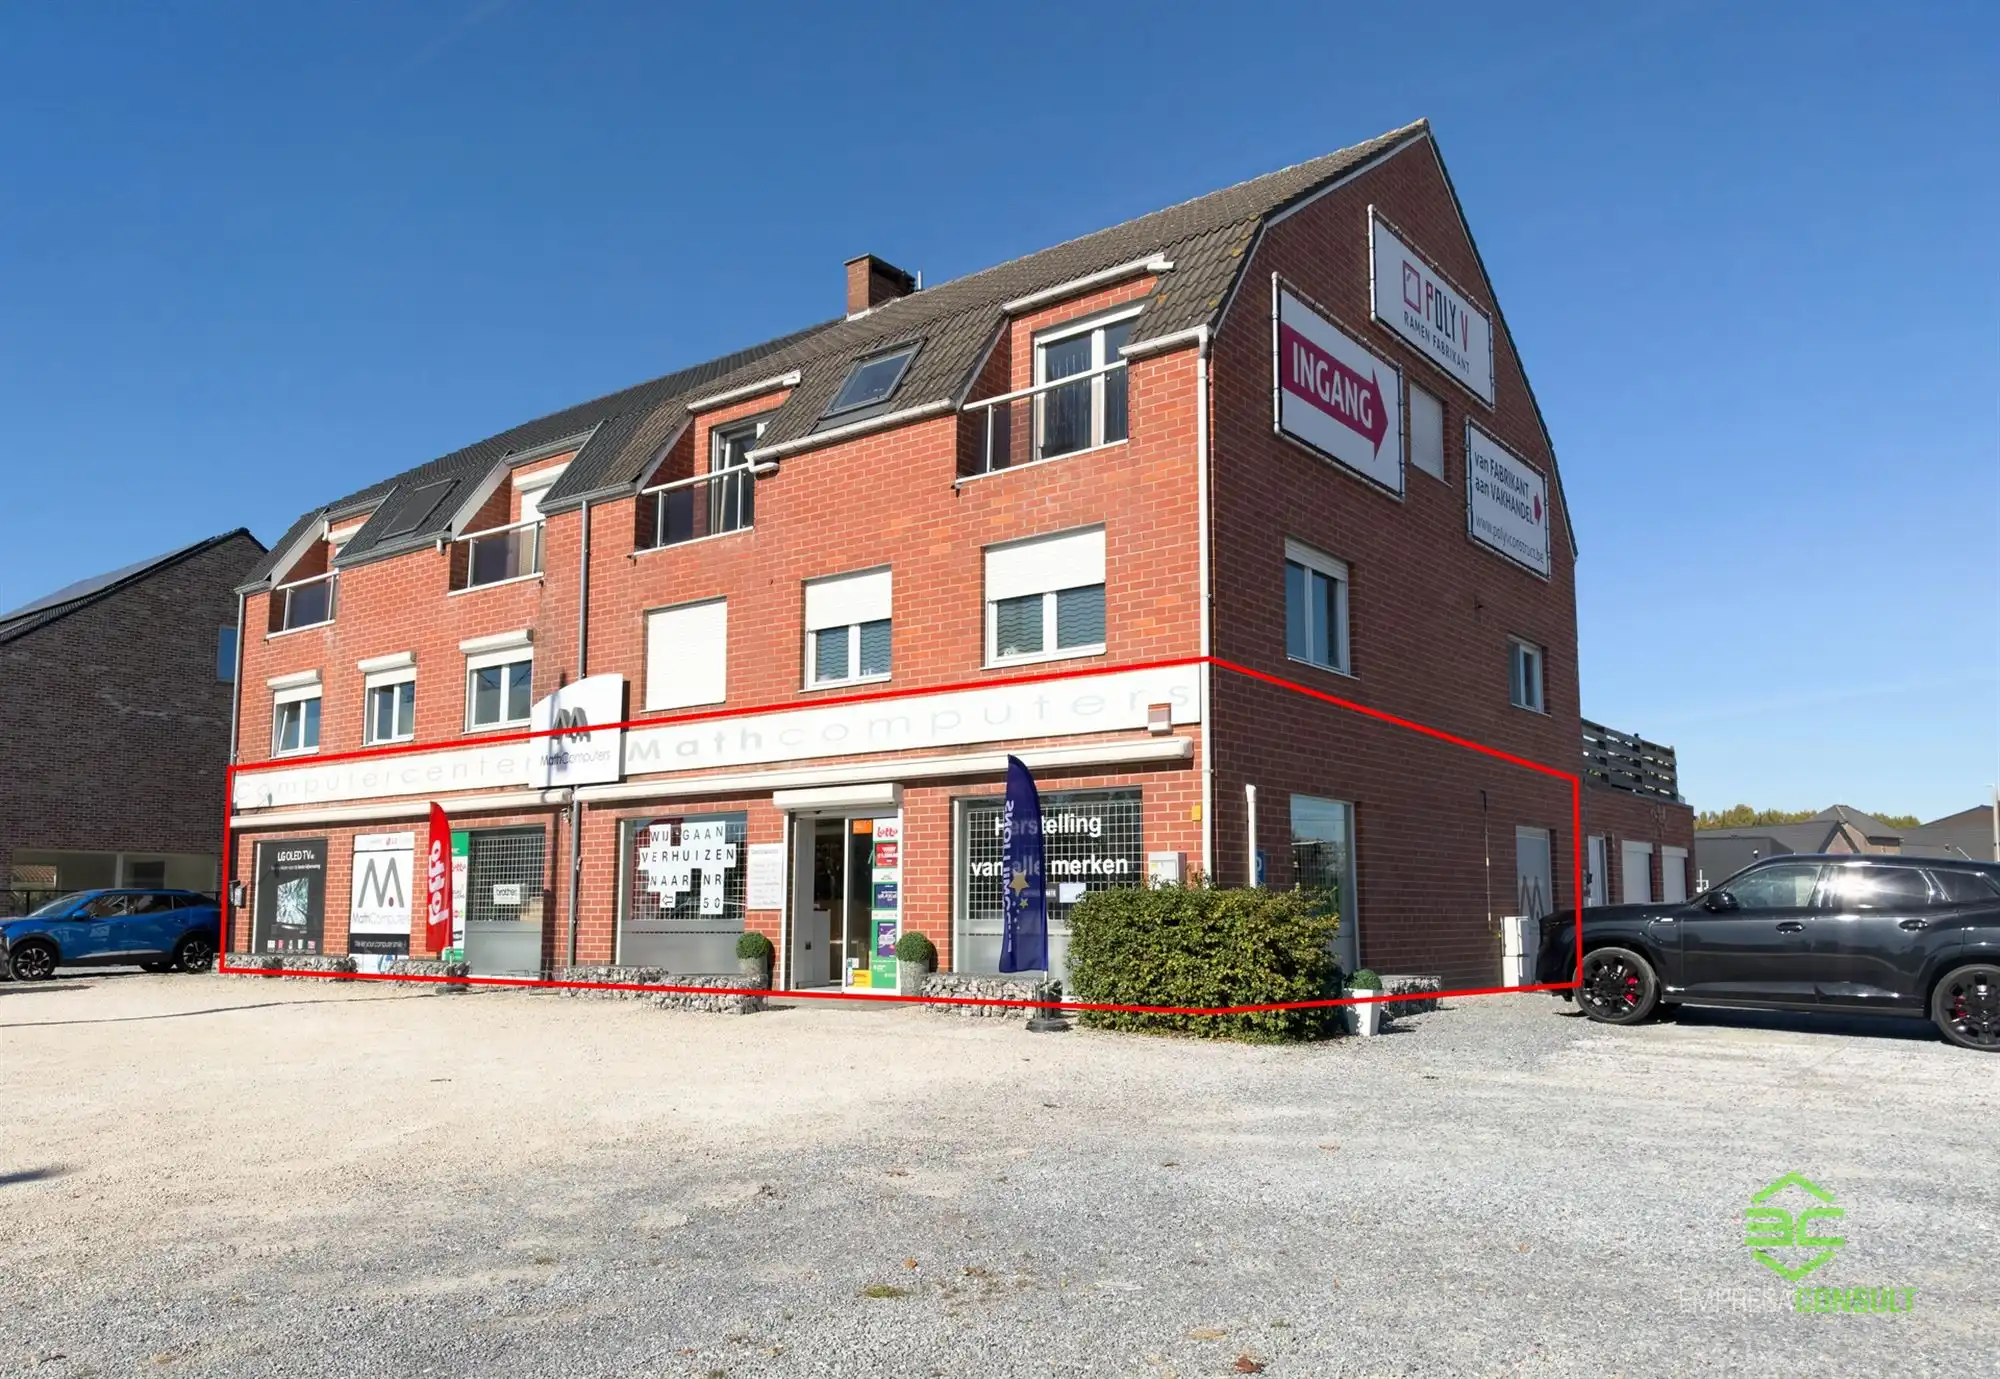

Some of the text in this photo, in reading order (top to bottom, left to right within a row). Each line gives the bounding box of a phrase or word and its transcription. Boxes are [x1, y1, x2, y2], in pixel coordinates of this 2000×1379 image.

[1426, 279, 1468, 353] POLY V
[1404, 310, 1470, 375] RAMEN FABRIKANT
[1292, 341, 1373, 430] INGANG
[1474, 451, 1529, 500] van FABRIKANT
[1475, 476, 1534, 525] aan VAKHANDEL
[540, 749, 611, 767] MathComputers
[651, 825, 724, 842] WIJ GAAN
[277, 851, 286, 862] LG
[286, 850, 303, 861] OLED
[302, 849, 312, 860] TV
[641, 848, 735, 863] VERHUIZEN
[971, 861, 1003, 877] van
[1051, 853, 1128, 875] merken
[649, 873, 722, 887] NAAR NR
[703, 897, 721, 909] 50
